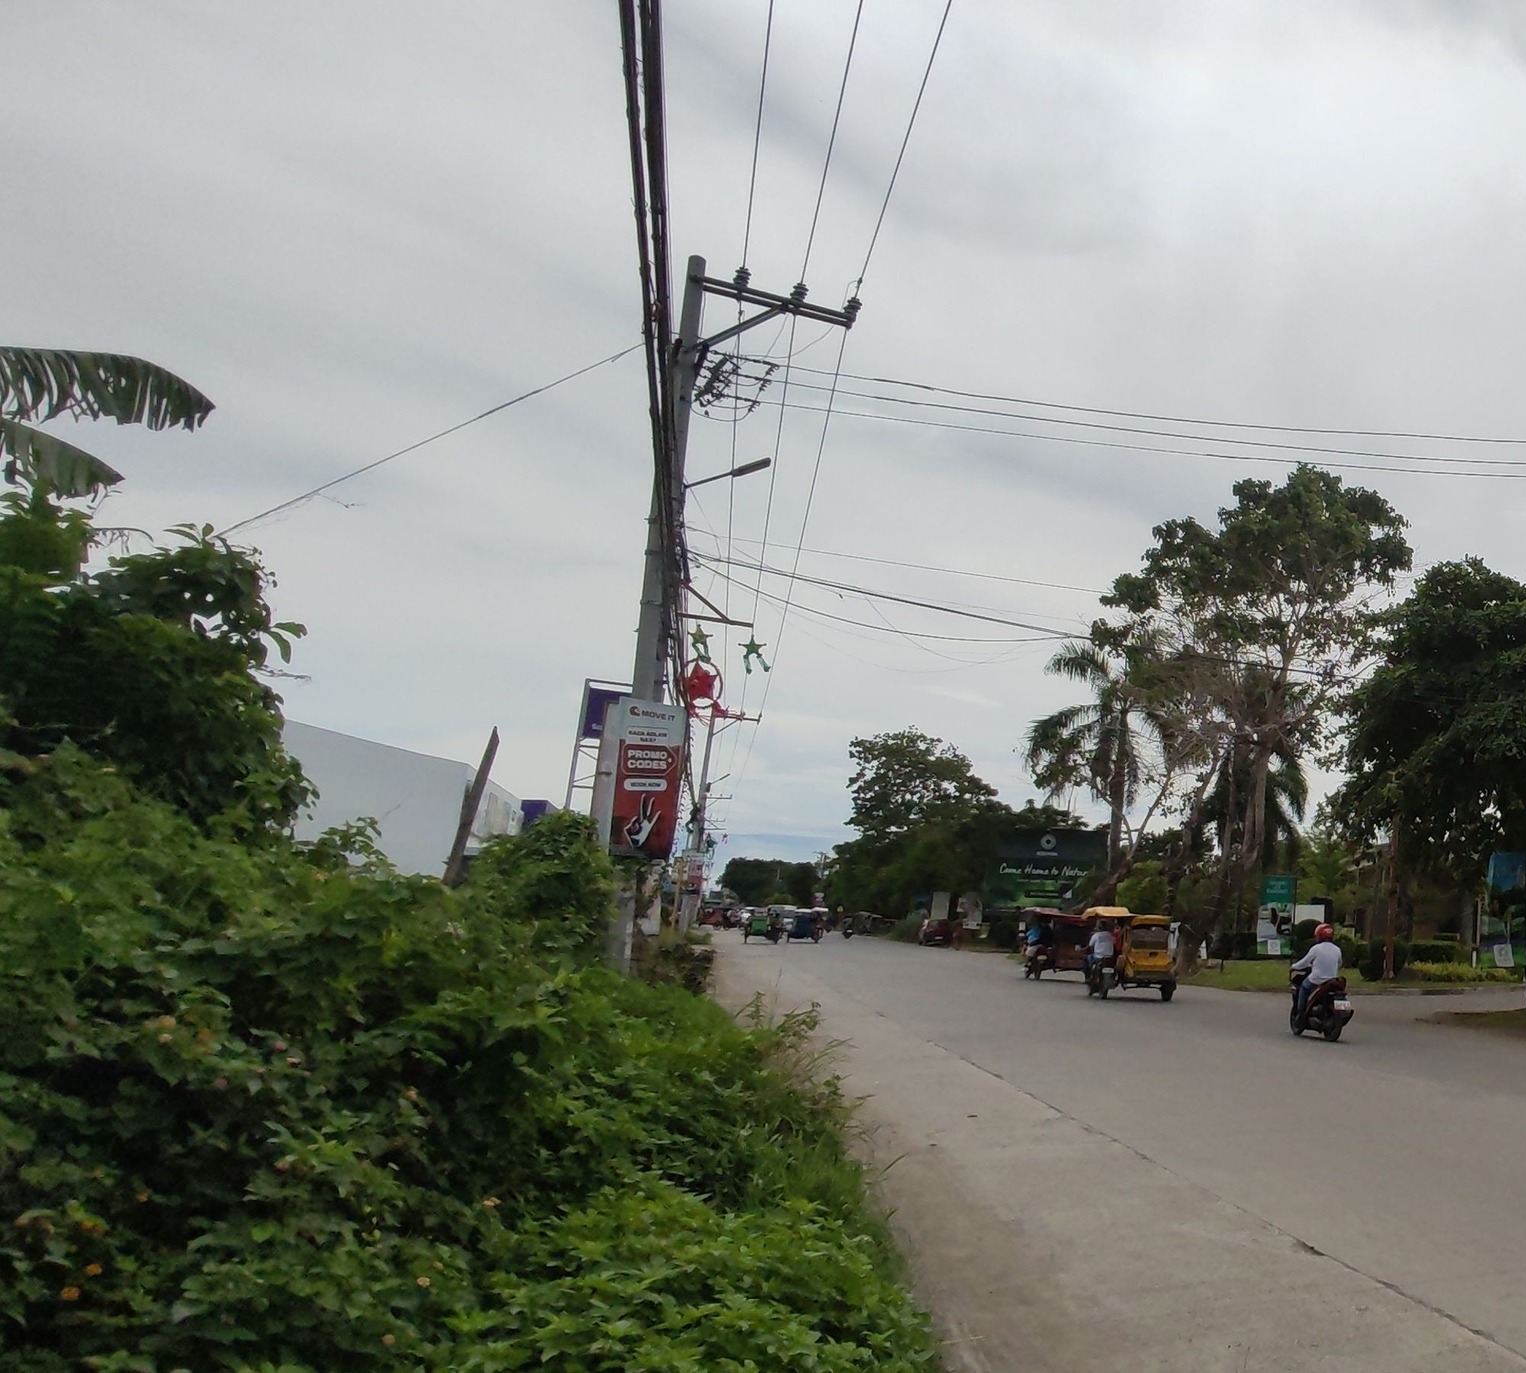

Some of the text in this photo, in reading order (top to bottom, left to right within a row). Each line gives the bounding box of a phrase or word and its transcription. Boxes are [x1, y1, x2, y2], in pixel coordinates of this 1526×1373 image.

[641, 710, 676, 721] MOVE IT
[627, 749, 668, 760] PROMO
[627, 760, 667, 770] CODES
[999, 863, 1022, 874] Come
[1024, 863, 1049, 875] Home
